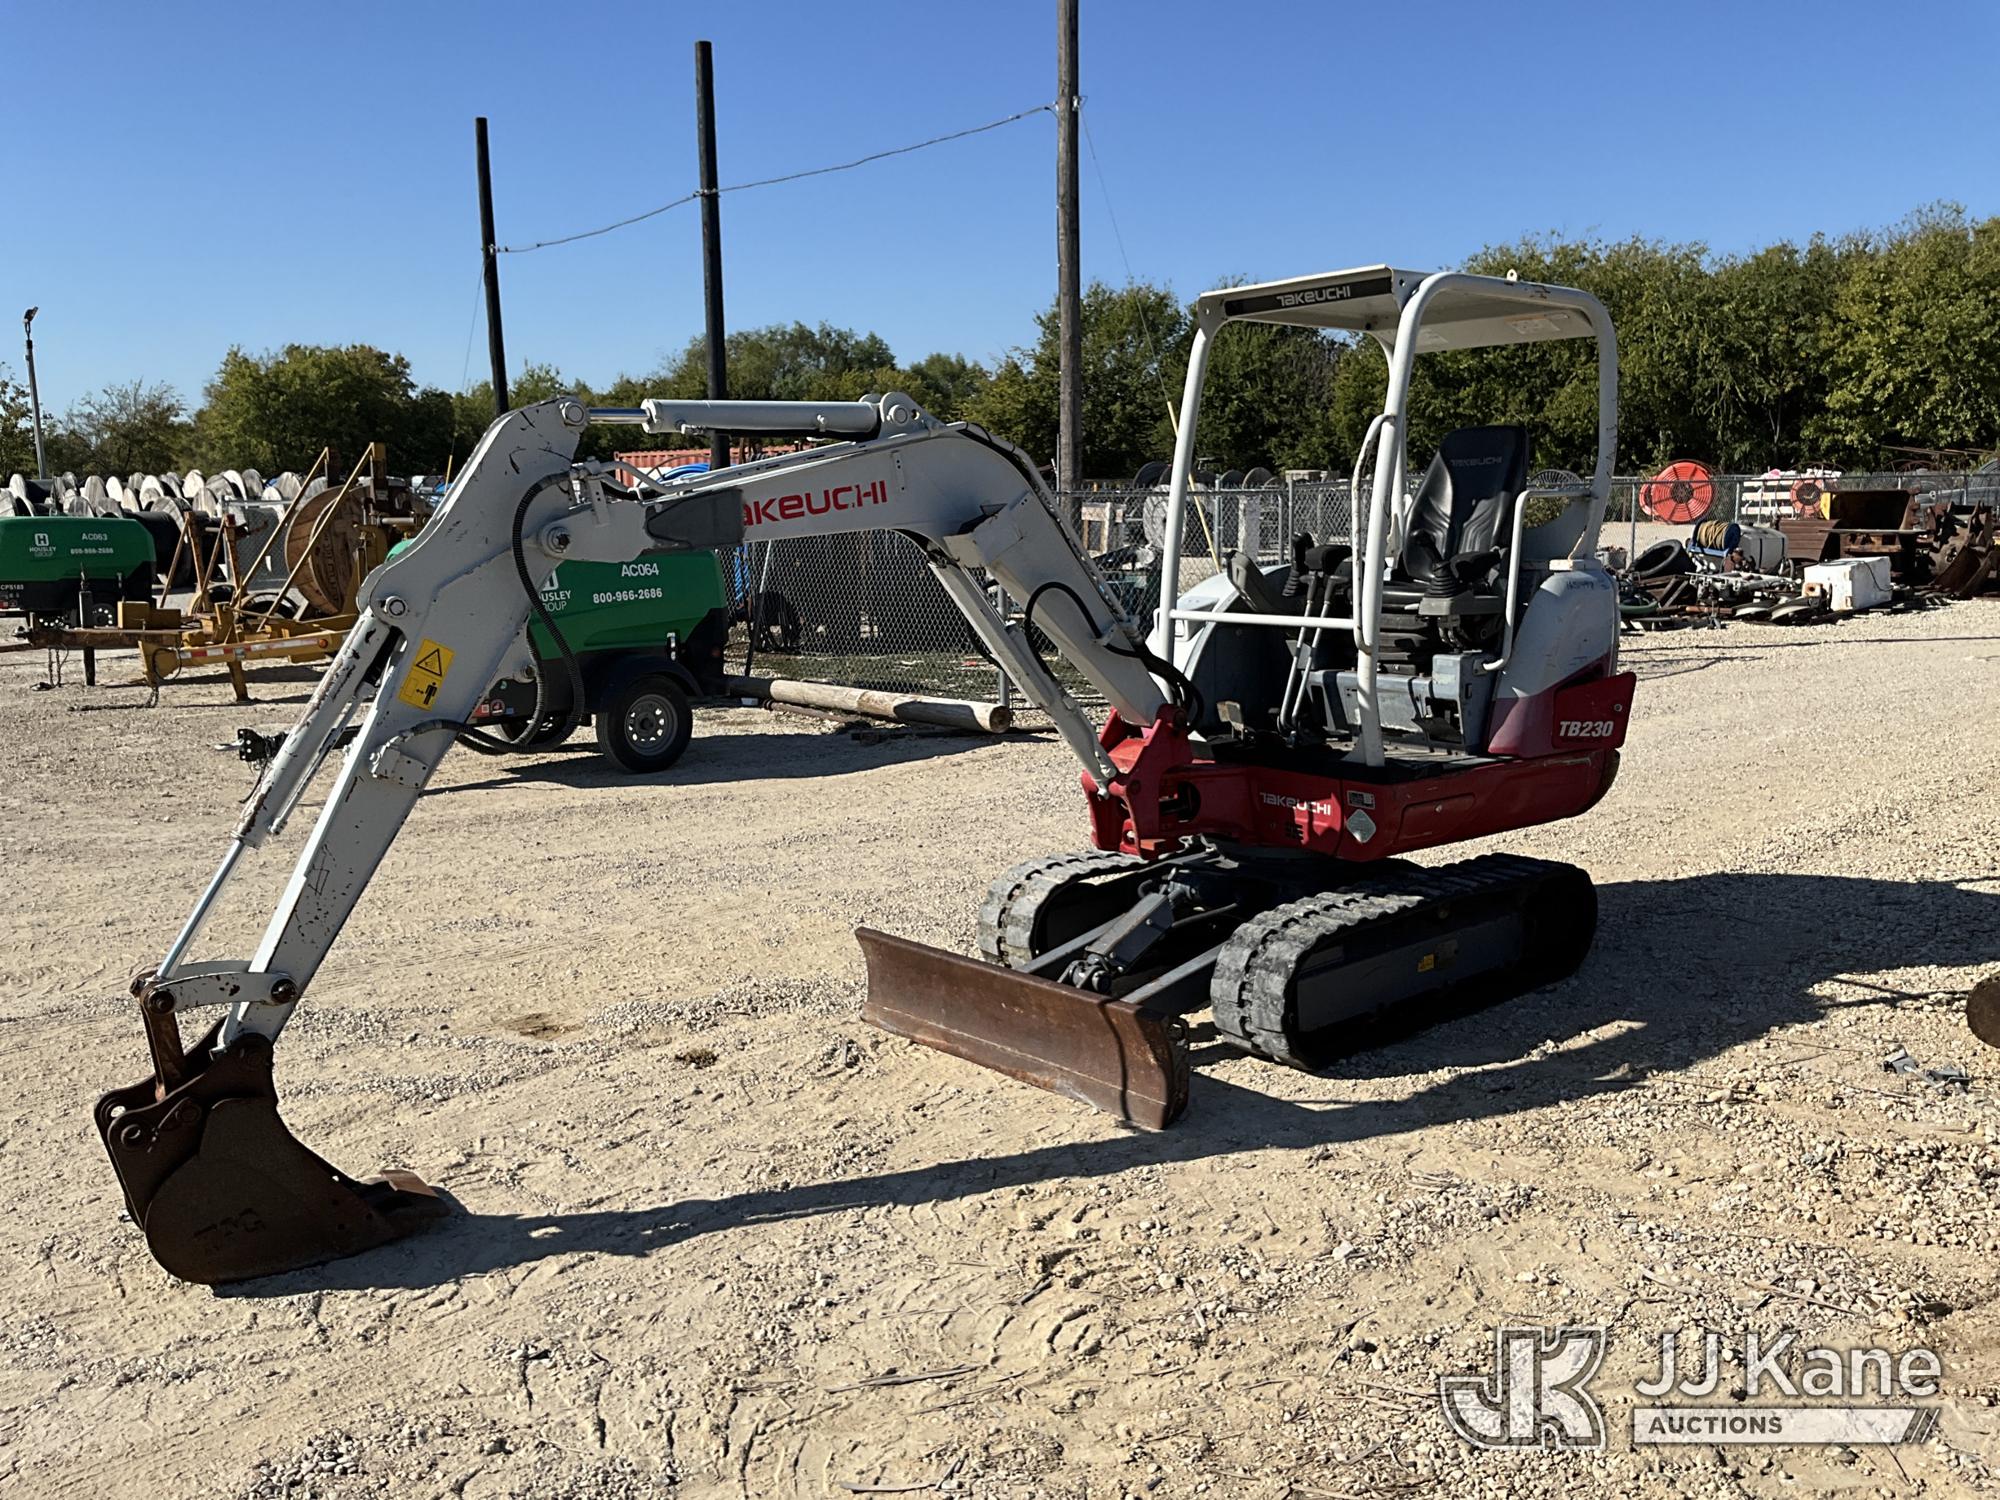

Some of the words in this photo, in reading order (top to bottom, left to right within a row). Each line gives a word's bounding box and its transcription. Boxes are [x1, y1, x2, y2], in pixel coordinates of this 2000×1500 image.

[621, 563, 659, 578] AC064
[592, 587, 663, 604] 800-966-2686
[1559, 720, 1614, 737] TB230
